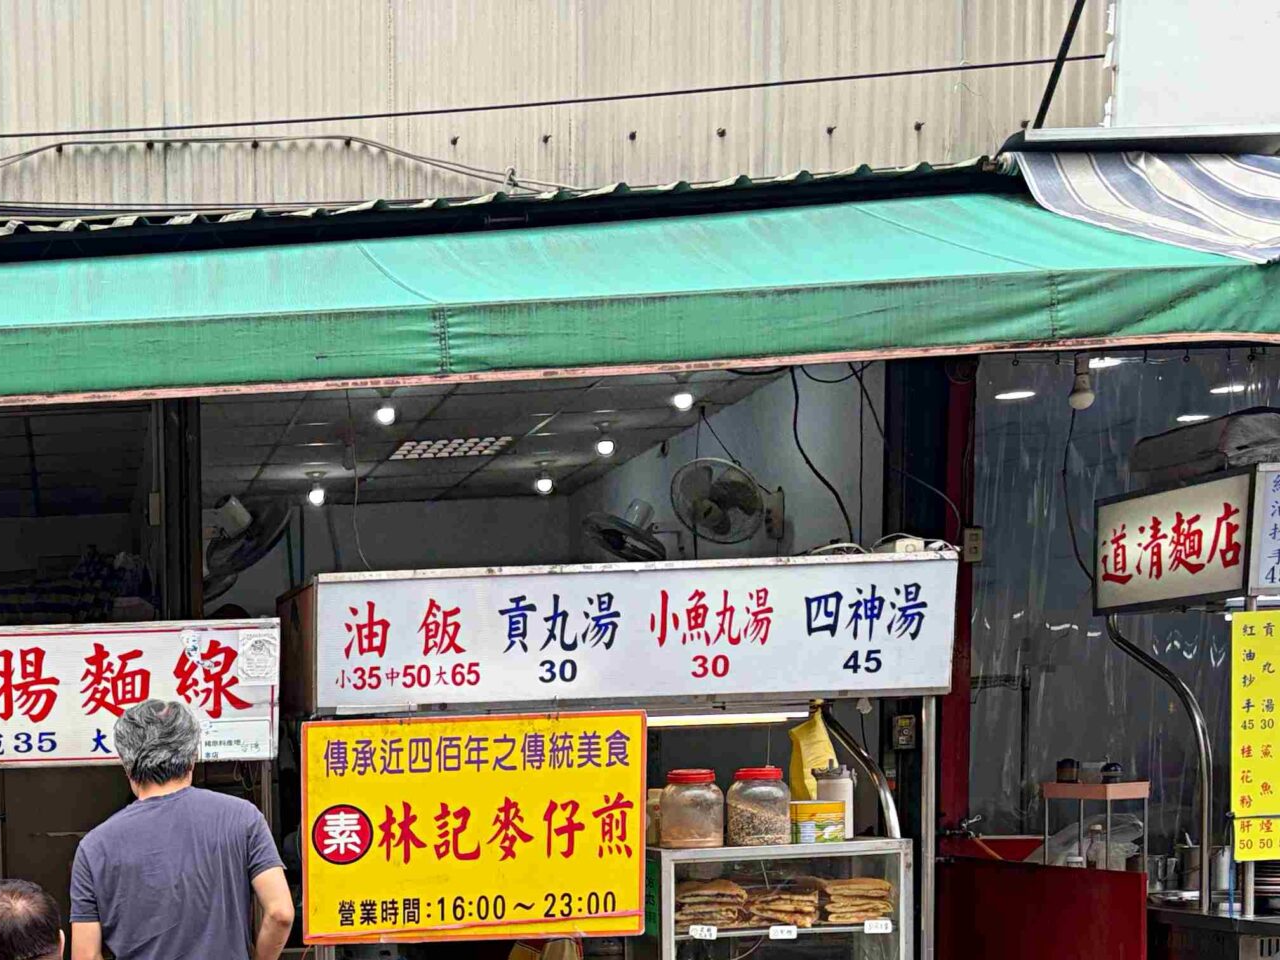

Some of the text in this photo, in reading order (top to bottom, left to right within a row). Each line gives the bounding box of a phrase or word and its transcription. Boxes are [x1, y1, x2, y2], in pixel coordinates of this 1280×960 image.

[1102, 502, 1241, 584] 道清麵店
[344, 598, 466, 659] 油飯
[498, 591, 622, 654] 貢丸湯
[650, 586, 774, 647] 小魚丸湯
[804, 582, 928, 642] 四神湯
[538, 659, 578, 684] 30
[691, 654, 730, 678] 30
[842, 649, 883, 674] 45
[1260, 622, 1276, 730] 貢丸湯 30
[13, 731, 58, 754] 35
[1240, 719, 1255, 730] 45
[323, 730, 632, 778] 傳承近四佰年之傳統美食
[322, 811, 362, 855] 素
[378, 792, 635, 865] 林記麥仔煎
[1239, 838, 1253, 850] 50
[1259, 838, 1274, 849] 50
